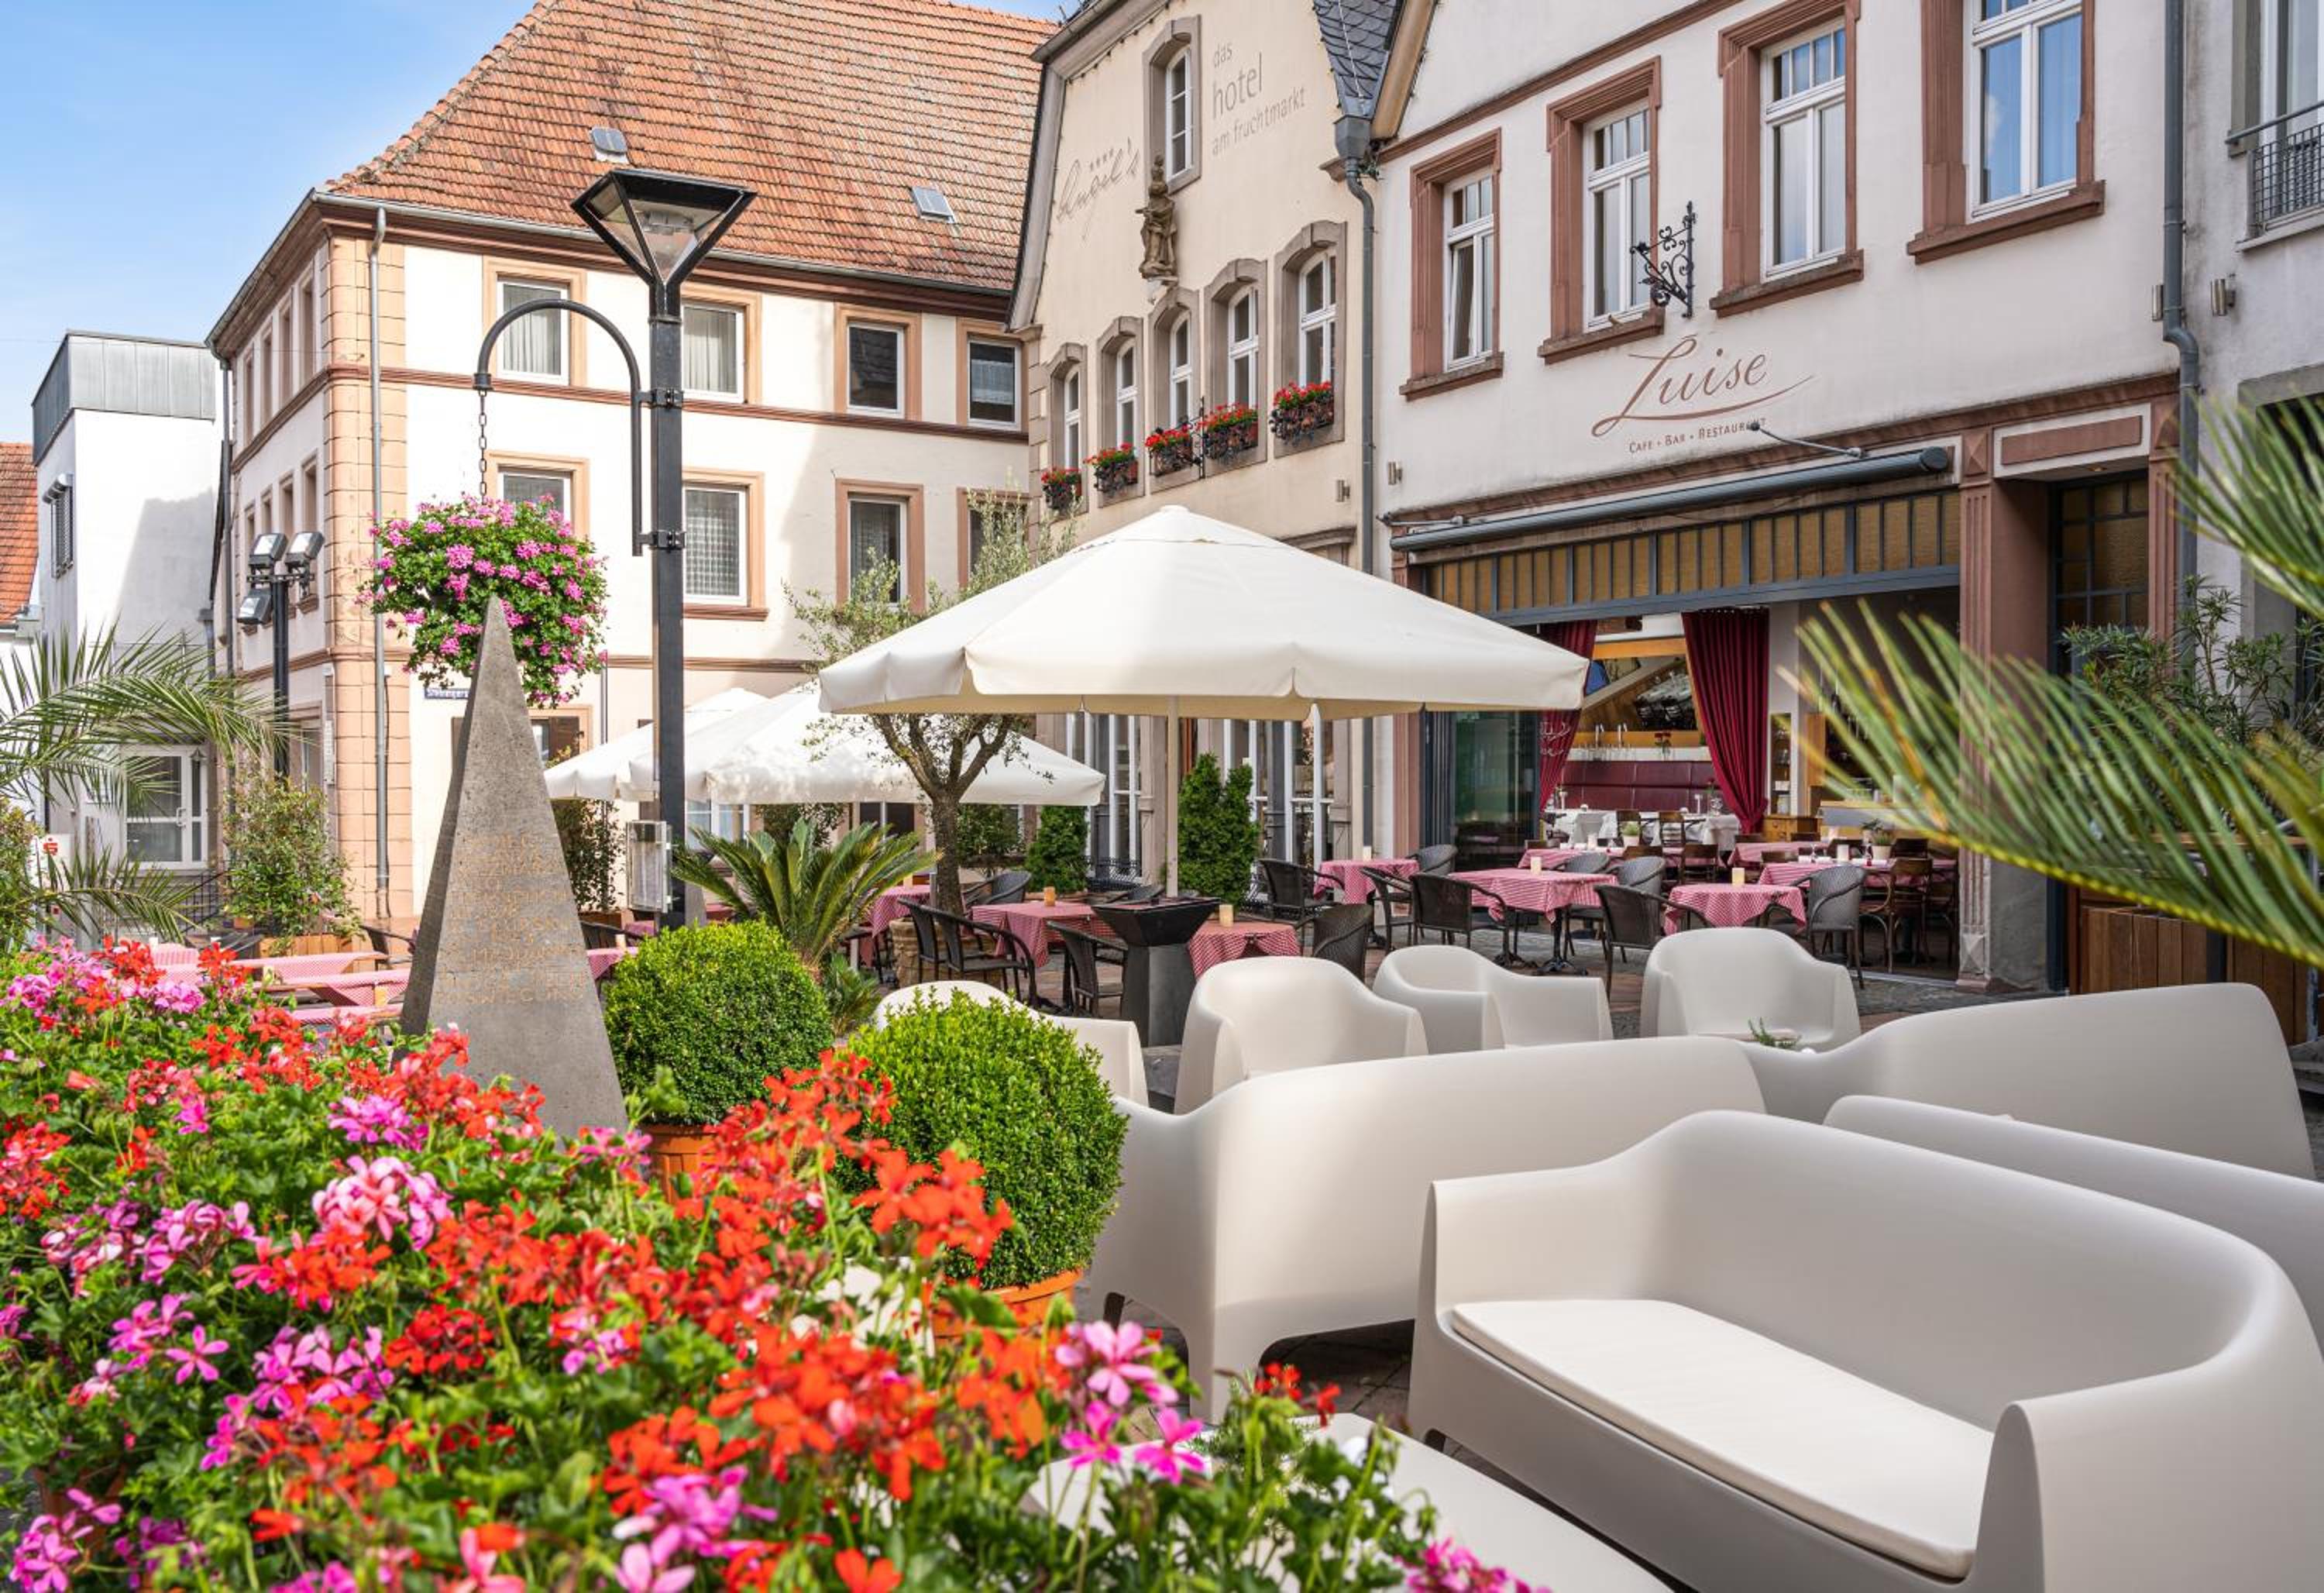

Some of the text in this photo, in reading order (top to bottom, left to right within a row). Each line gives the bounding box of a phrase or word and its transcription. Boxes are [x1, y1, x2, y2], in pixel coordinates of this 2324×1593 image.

[1212, 52, 1262, 119] hotel
[1213, 41, 1232, 68] das
[1211, 86, 1305, 157] am fruchtmarkt
[1591, 334, 1782, 437] Luise
[1699, 418, 1767, 439] RESTAURT
